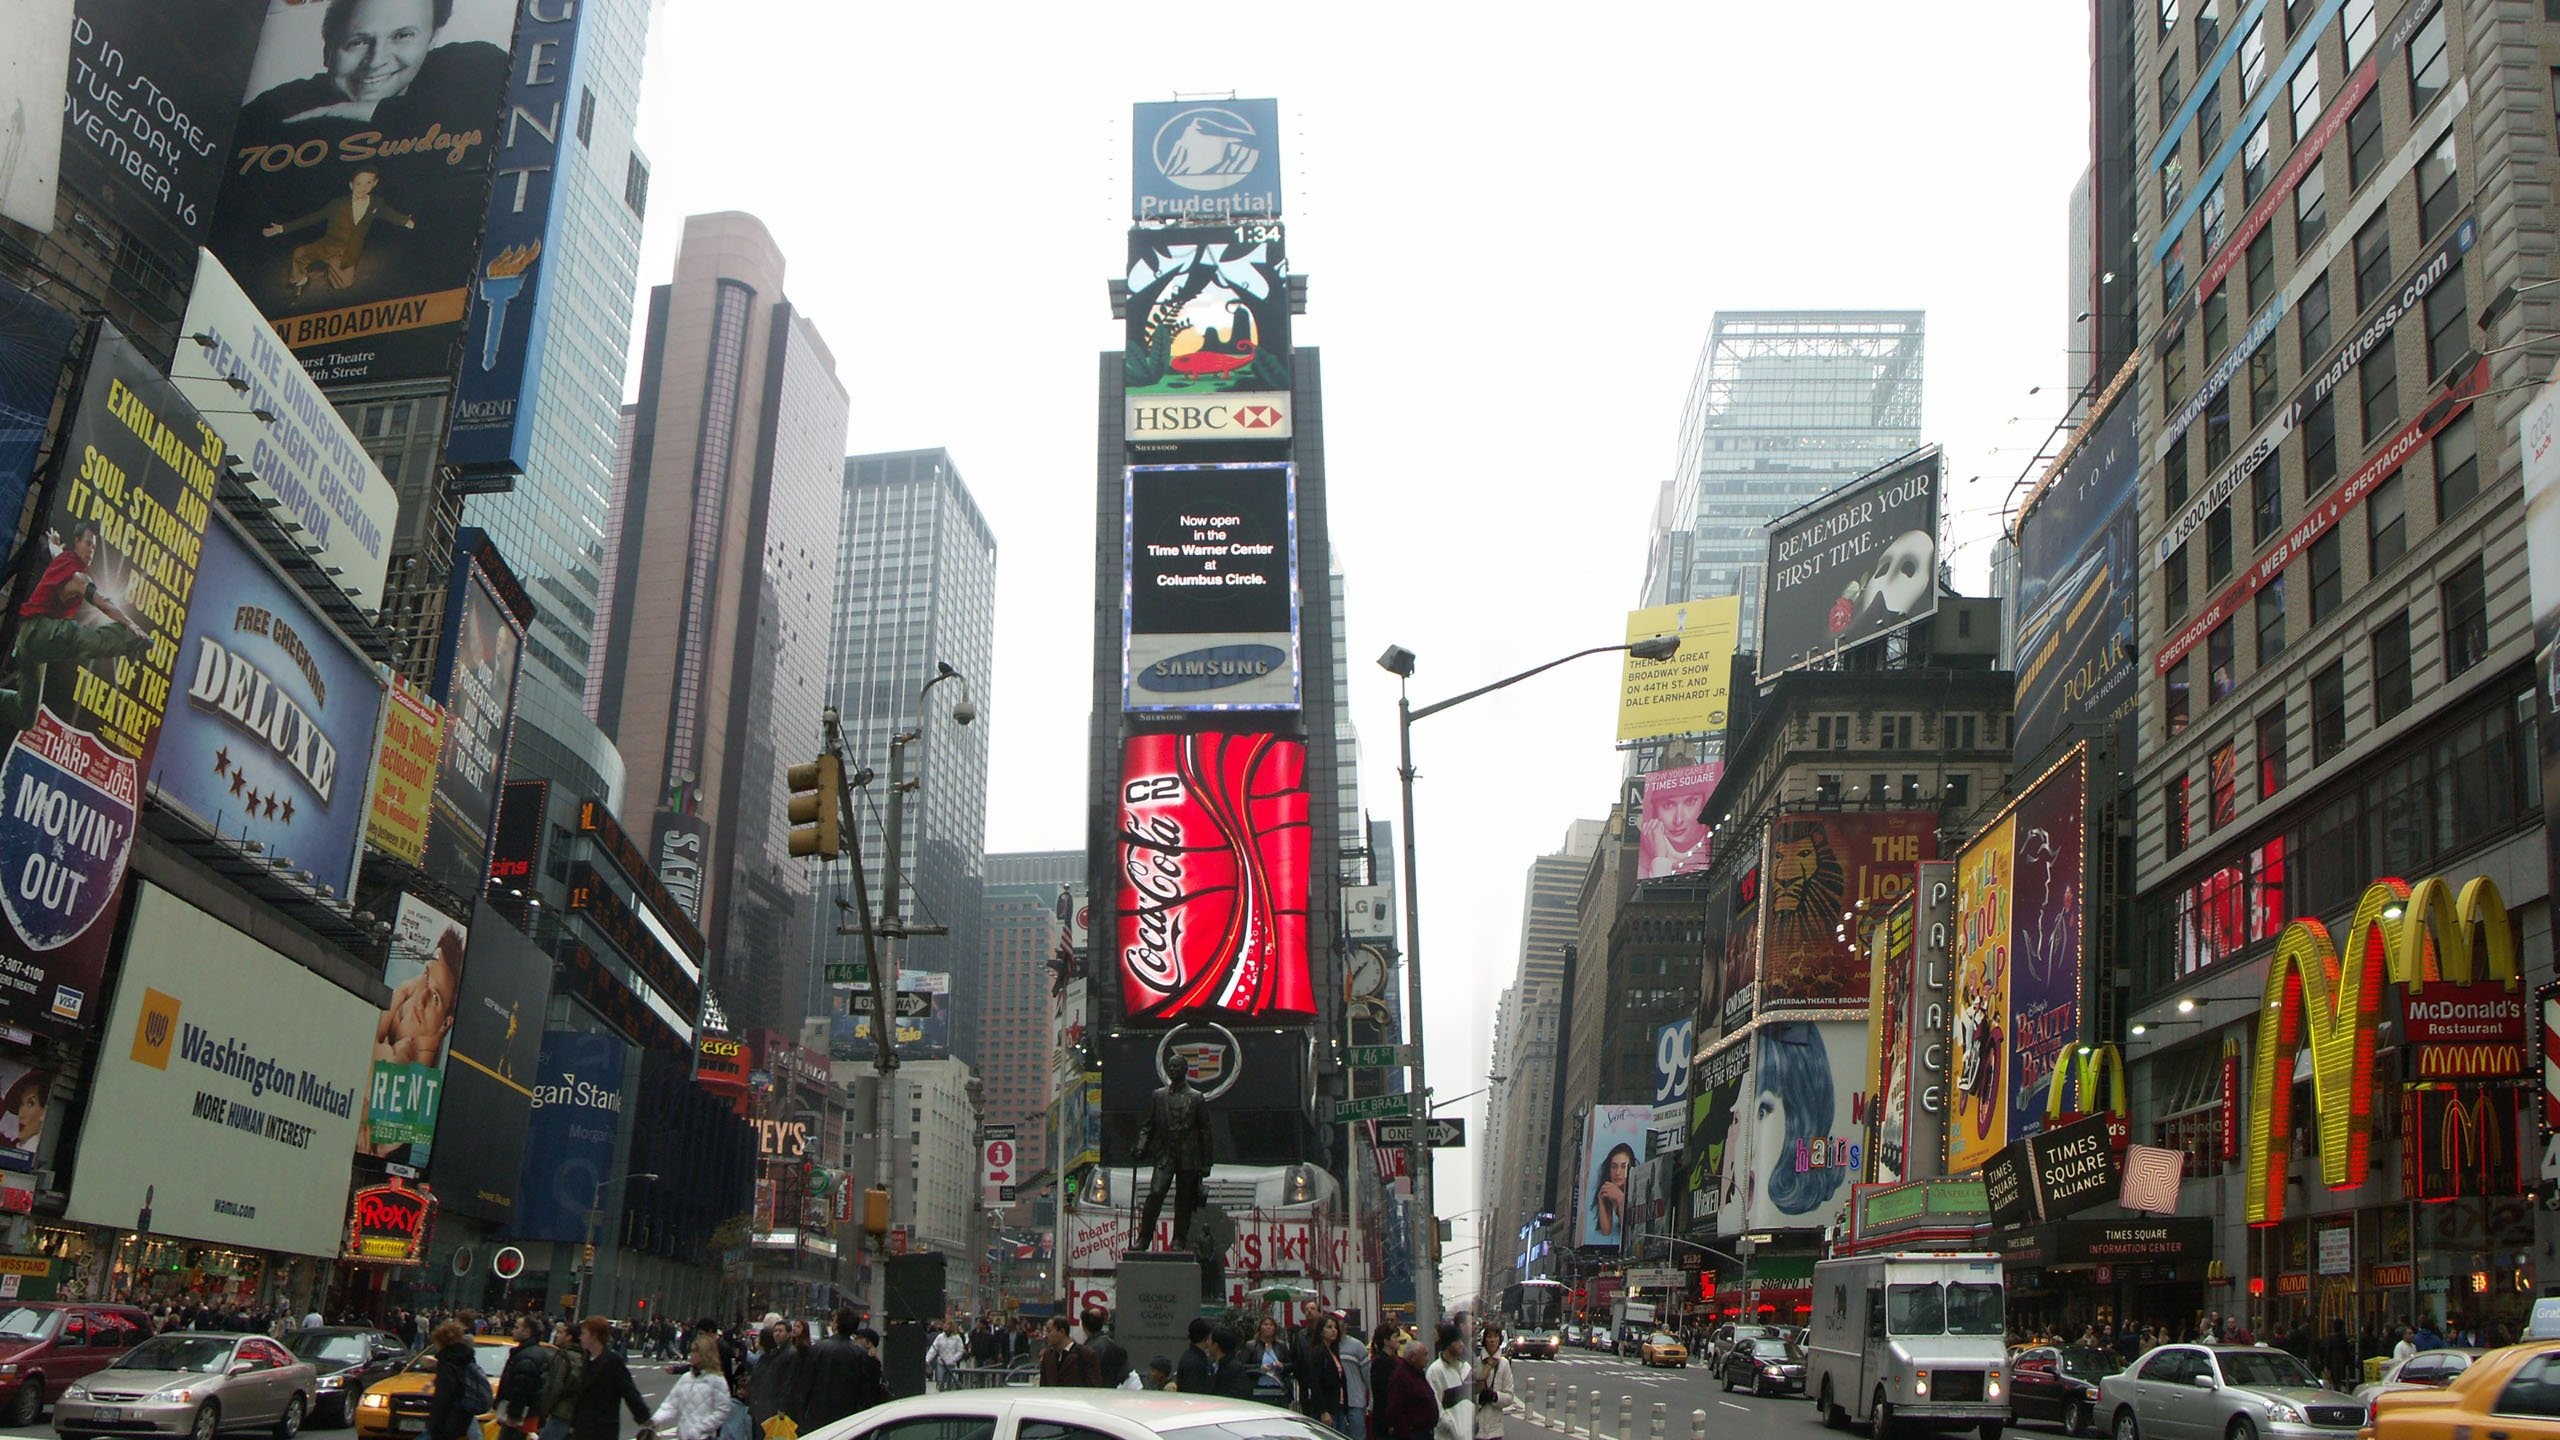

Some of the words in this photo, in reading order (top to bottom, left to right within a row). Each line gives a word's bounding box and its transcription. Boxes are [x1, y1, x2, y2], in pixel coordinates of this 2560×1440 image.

[76, 57, 181, 175] TUESDAY,
[127, 75, 216, 157] STORES
[238, 139, 329, 176] 700
[337, 123, 483, 166] Sundays
[176, 192, 197, 226] 16
[1140, 191, 1274, 214] Prudential
[1234, 226, 1281, 244] 1:34
[297, 299, 429, 343] BROADWAY
[2314, 250, 2449, 401] mattress.com
[327, 350, 376, 366] Theatre
[331, 365, 368, 379] Street
[250, 324, 283, 388] THE
[282, 368, 367, 495] UNDISPUTED
[1134, 406, 1229, 432] HSBC
[2169, 388, 2208, 442] THINKING
[106, 377, 216, 502] EXHILARATING
[175, 486, 209, 535] AND
[252, 437, 331, 552] CHAMPION.
[318, 463, 382, 562] CHECKING
[1180, 515, 1207, 527] Now
[1209, 515, 1240, 529] open
[1777, 501, 1874, 563] REMEMBER
[1877, 474, 1930, 514] YOUR
[66, 478, 92, 520] IT
[90, 494, 195, 604] PRACTICALLY
[1147, 544, 1179, 557] Time
[1181, 544, 1228, 557] Warner
[1230, 543, 1274, 556] Center
[1193, 529, 1205, 541] in
[1206, 529, 1227, 541] the
[2259, 546, 2288, 578] WEB
[2290, 516, 2327, 555] WALL
[1156, 574, 1223, 586] Columbus
[1225, 573, 1267, 586] Circle.
[1204, 560, 1217, 571] at
[1775, 553, 1825, 593] FIRST
[126, 568, 186, 640] BURSTS
[2159, 604, 2221, 669] SPECTACOLOR
[233, 605, 273, 637] FREE
[272, 617, 326, 712] CHECKING
[1155, 659, 1269, 678] SAMSUNG
[1628, 667, 1679, 682] BROADWAY
[1681, 664, 1710, 676] SHOW
[1680, 651, 1710, 664] GREAT
[2061, 632, 2126, 715] POLAR
[138, 665, 171, 713] THE
[459, 662, 503, 730] FOREFATHERS
[1625, 695, 1650, 708] DALE
[1652, 690, 1711, 705] EARNHARDT
[1712, 687, 1728, 698] JR.
[1627, 683, 1641, 695] ON
[1643, 680, 1669, 692] 44TH
[1670, 680, 1685, 691] ST.
[1686, 676, 1708, 687] AND
[188, 636, 337, 805] DELUXE
[463, 699, 478, 730] DID
[476, 713, 492, 744] NOT
[2083, 695, 2100, 714] THIS
[43, 730, 91, 775] THARP
[453, 716, 476, 755] COME
[474, 737, 492, 774] HERE
[454, 747, 466, 772] TO
[103, 769, 134, 804] JOEL
[1651, 778, 1678, 791] TIMES
[1679, 772, 1715, 787] SQUARE
[1666, 769, 1681, 780] YOU
[1681, 766, 1703, 778] CARE
[1125, 777, 1181, 804] C2
[13, 772, 124, 862] MOVIN'
[1871, 834, 1920, 862] THE
[19, 851, 88, 917] OUT
[1974, 848, 1999, 908] ALL
[1125, 808, 1183, 995] Coca-Cola
[1960, 886, 2008, 957] SHOOK
[839, 965, 853, 980] 46
[1984, 944, 2007, 995] UP
[59, 995, 78, 1010] VISA
[1922, 881, 1948, 1113] PALACE
[2409, 1000, 2521, 1022] McDonald's
[2015, 1001, 2073, 1054] BEAUTY
[2428, 1022, 2503, 1036] Restaurant
[180, 1022, 296, 1098] Washington
[296, 1069, 355, 1120] Mutual
[1350, 1048, 1360, 1065] W
[1363, 1050, 1378, 1065] 46
[371, 1071, 438, 1117] RENT
[1704, 1078, 1714, 1092] OF
[1713, 1070, 1726, 1086] THE
[192, 1090, 227, 1125] MORE
[226, 1101, 266, 1138] HUMAN
[1336, 1101, 1367, 1116] LITTLE
[1370, 1095, 1408, 1111] BRAZIL
[1388, 1126, 1413, 1141] ONE
[2046, 1134, 2098, 1165] TIMES
[1988, 1159, 2013, 1184] TIMES
[2045, 1152, 2107, 1186] SQUARE
[2052, 1171, 2107, 1201] ALLIANCE
[1988, 1173, 2019, 1202] SQUARE
[1993, 1187, 2020, 1213] ALLIANCE
[213, 1198, 256, 1220] wamu.com
[2089, 1244, 2148, 1255] INFORMATION
[2148, 1242, 2182, 1253] CENTER
[2105, 1230, 2133, 1240] TIMES
[2134, 1228, 2168, 1240] SQUARE
[1760, 1277, 1799, 1291] sbarro
